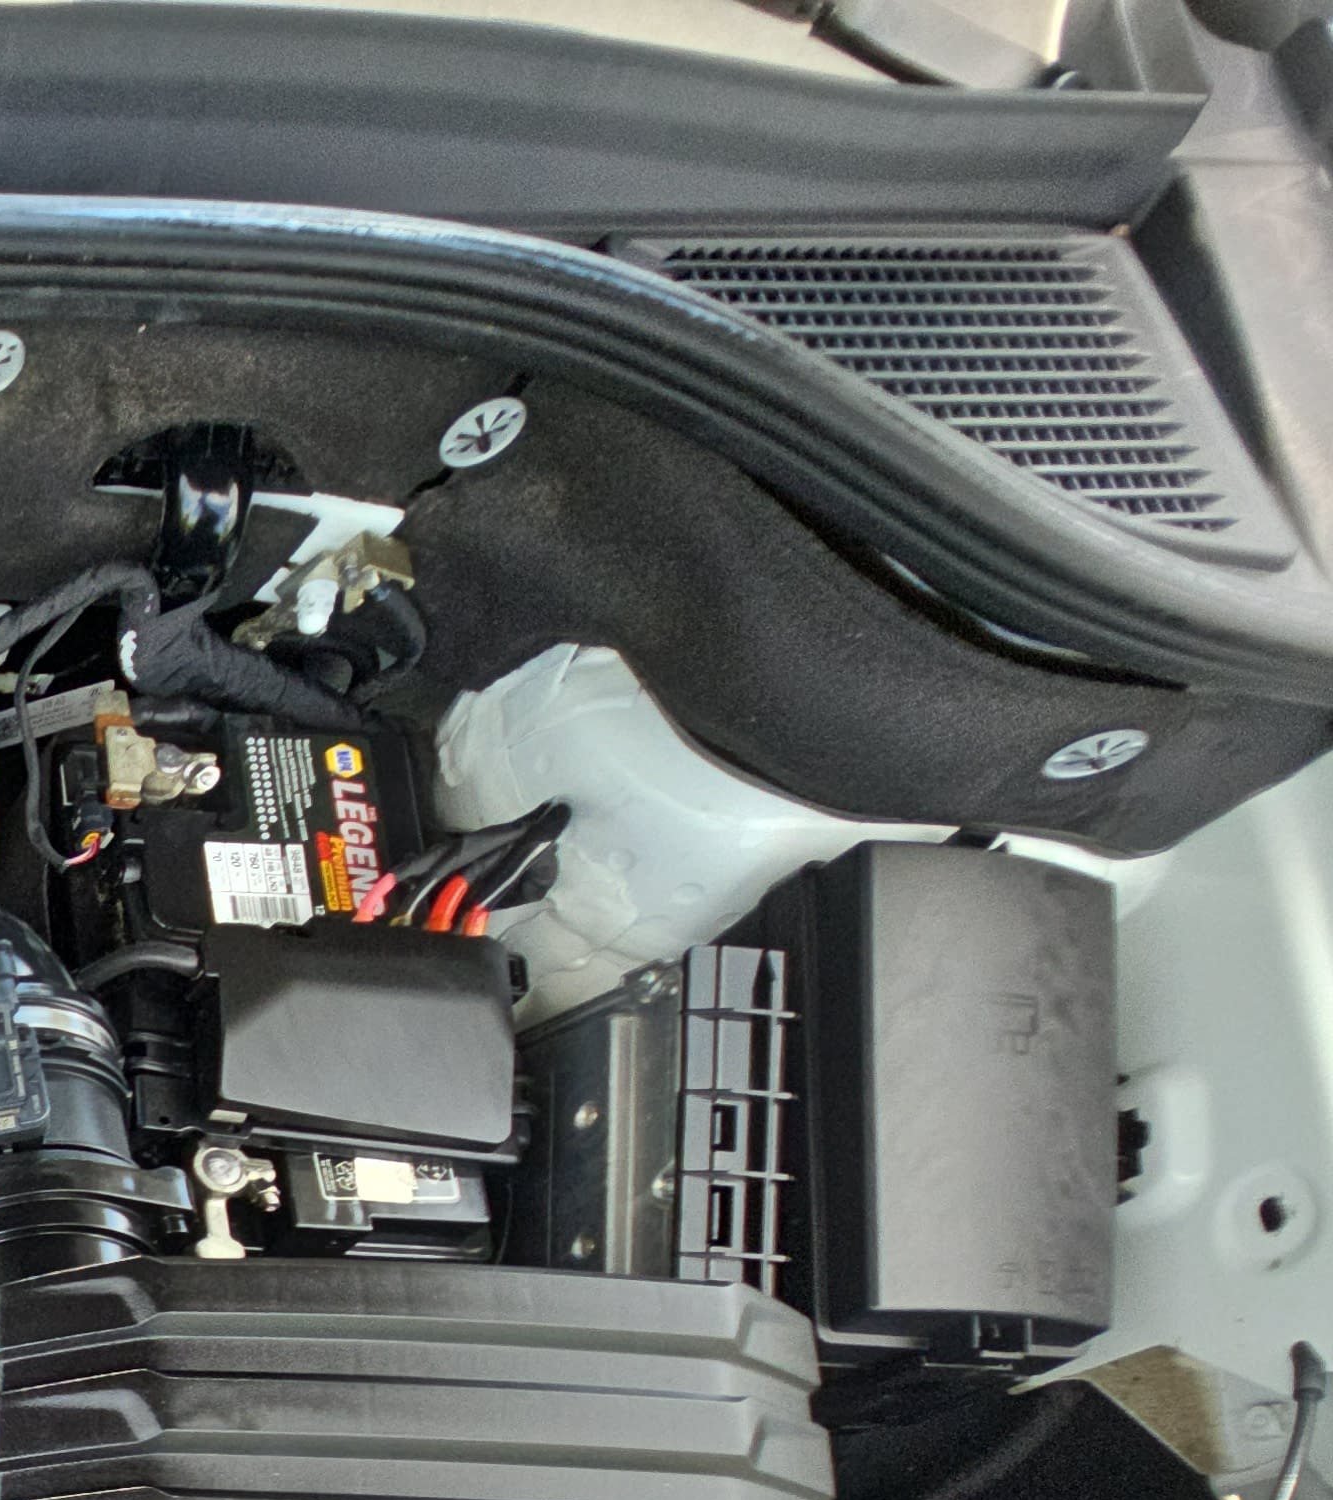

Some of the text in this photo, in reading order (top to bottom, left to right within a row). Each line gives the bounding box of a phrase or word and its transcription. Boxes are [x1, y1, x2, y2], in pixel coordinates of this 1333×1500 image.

[212, 850, 221, 863] 70
[231, 851, 240, 867] 120
[249, 852, 259, 869] 760
